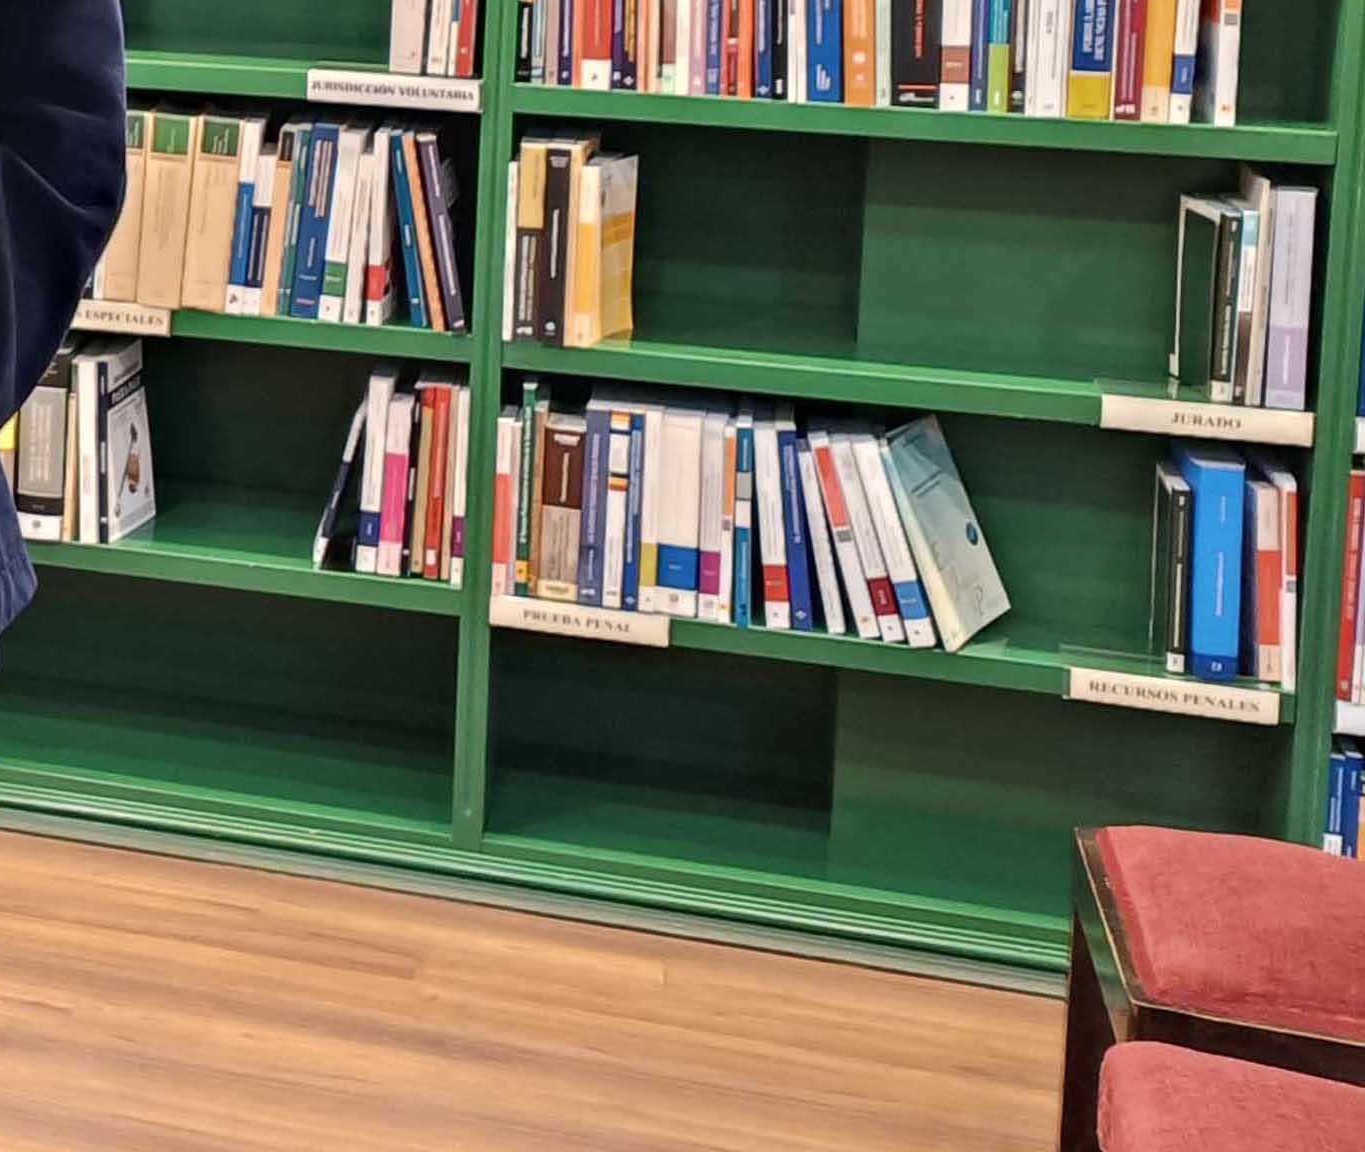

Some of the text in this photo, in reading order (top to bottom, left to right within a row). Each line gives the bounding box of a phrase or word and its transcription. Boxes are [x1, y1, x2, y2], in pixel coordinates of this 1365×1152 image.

[311, 80, 475, 101] JURISDICCIÓN VOLUNTARIA
[84, 309, 164, 325] ESPECIALES
[1170, 411, 1243, 429] JURADO
[523, 609, 631, 633] PRUEBA PENAL
[1088, 678, 1261, 713] RECURSOS PENALES
